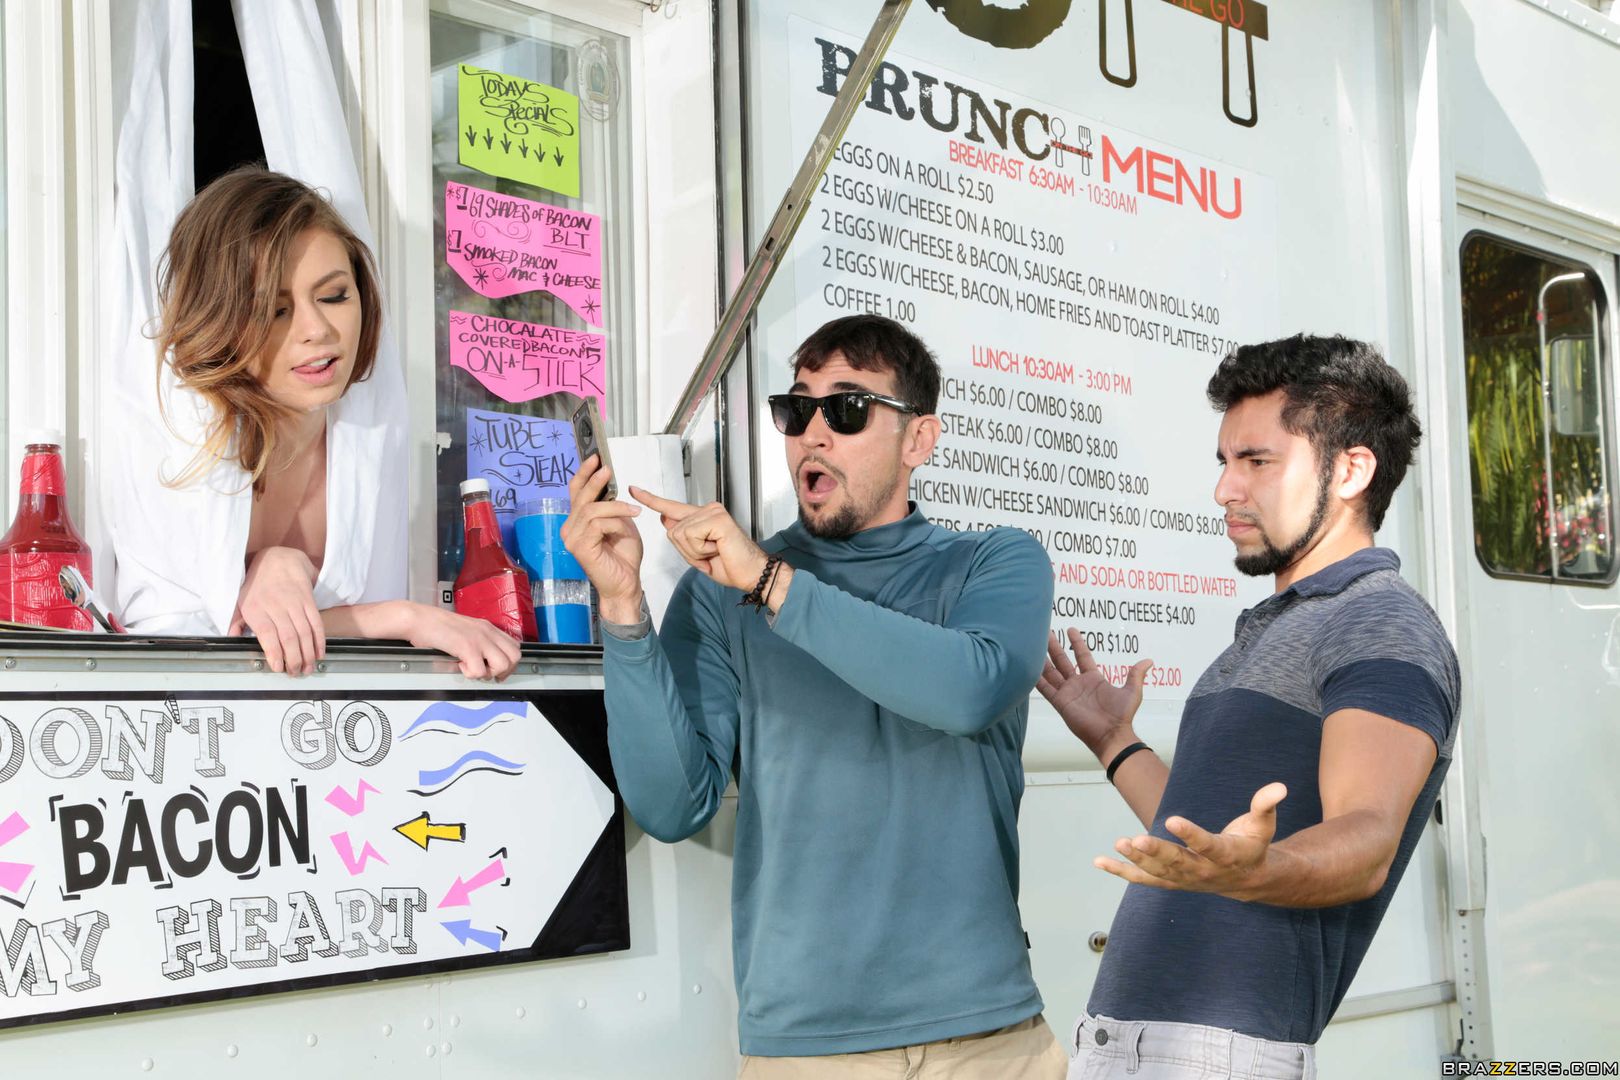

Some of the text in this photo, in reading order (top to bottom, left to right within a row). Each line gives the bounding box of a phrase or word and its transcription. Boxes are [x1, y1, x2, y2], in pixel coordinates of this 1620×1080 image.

[877, 152, 900, 178] ON
[904, 160, 914, 182] A
[918, 163, 954, 193] ROLL
[958, 174, 993, 204] $2.50
[949, 140, 1024, 182] BREAKFAST
[1029, 165, 1074, 197] 6:30AM
[1088, 183, 1137, 216] 10:30AM
[1101, 134, 1242, 219] MENU
[469, 191, 484, 218] 69
[486, 197, 529, 223] SHADES
[545, 209, 592, 232] BACON
[820, 173, 1064, 256] 2 EGGS W/CHEESE ON A ROLL $3.00
[550, 227, 591, 249] BLT
[507, 267, 537, 282] MAC
[553, 273, 601, 289] CHEESE
[520, 253, 558, 270] BACON
[821, 208, 1220, 326] 2 EGGS W/CHEESE & BACON, SAUSAGE, OR HAM ON ROLL $4.00
[822, 245, 832, 268] 2
[836, 248, 877, 278] EGGS
[879, 258, 958, 300] W/CHEESE,
[961, 278, 1013, 312] BACON,
[1016, 290, 1056, 319] HOME
[1059, 301, 1091, 326] FRIES
[1094, 309, 1121, 333] AND
[1122, 315, 1161, 342] TOAST
[1163, 325, 1209, 352] PLATTER
[823, 283, 916, 323] COFFEE 1.00
[471, 315, 576, 343] CHOCALATE
[972, 344, 1020, 374] LUNCH
[1023, 355, 1074, 385] 10:30AM
[1086, 369, 1111, 393] 3:00
[1113, 373, 1132, 396] PM
[970, 381, 1006, 408] $6.00
[1008, 389, 1014, 410] /
[1017, 391, 1067, 418] COMBO
[1070, 399, 1102, 424] $8.00
[474, 415, 548, 452] TUBE
[941, 412, 1118, 459] STEAK $6.00 / COMBO $8.00
[484, 451, 576, 487] STEAK
[943, 447, 1020, 478] SANDWICH
[1023, 457, 1057, 483] $6.00
[1060, 464, 1066, 485] /
[1068, 465, 1116, 491] COMBO
[1118, 472, 1149, 495] $8.00
[963, 485, 1034, 514] W/CHEESE
[1037, 494, 1107, 522] SANDWICH
[1109, 502, 1141, 527] $6.00
[1142, 508, 1148, 528] /
[1150, 509, 1194, 532] COMBO
[1196, 513, 1225, 536] $8.00
[1045, 530, 1052, 551] /
[1054, 531, 1102, 555] COMBO
[1105, 535, 1136, 559] $7.00
[1060, 563, 1088, 585] AND
[1091, 566, 1126, 588] SODA
[1128, 569, 1145, 590] OR
[1148, 571, 1199, 594] BOTTLED
[1200, 576, 1237, 597] WATER
[1089, 599, 1116, 620] AND
[1119, 601, 1163, 623] CHEESE
[1166, 605, 1195, 626] $4.00
[1108, 632, 1139, 654] $1.00
[1152, 664, 1182, 687] $2.00
[281, 699, 392, 770] GO
[59, 785, 311, 893] BACON
[156, 887, 427, 981] HEART
